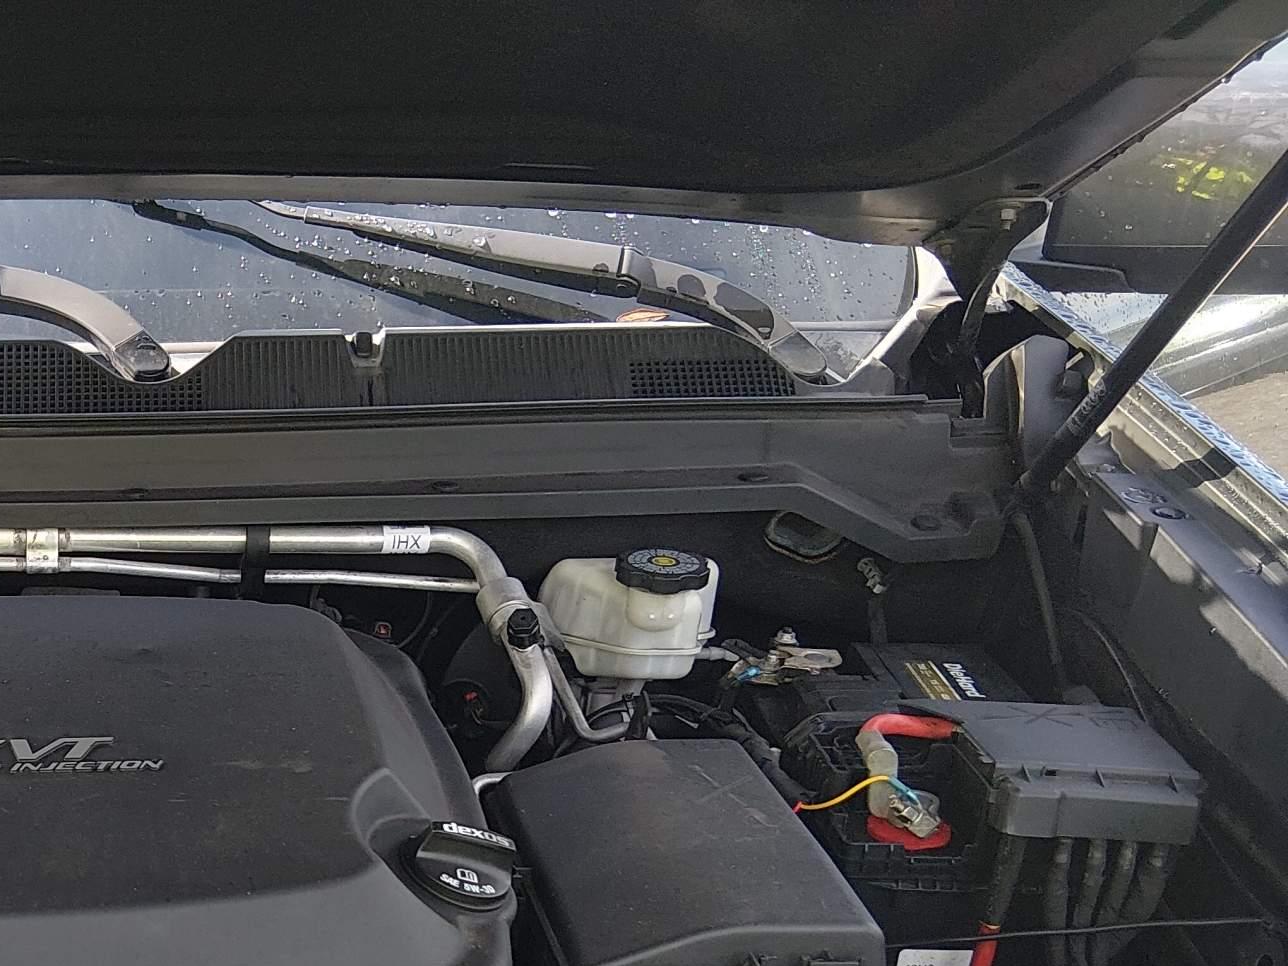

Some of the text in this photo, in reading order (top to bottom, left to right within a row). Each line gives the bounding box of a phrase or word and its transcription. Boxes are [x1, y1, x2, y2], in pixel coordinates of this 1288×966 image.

[392, 535, 421, 549] IHX
[942, 663, 987, 698] DieHard
[10, 758, 165, 773] INJECTION
[443, 823, 510, 846] dexos
[439, 873, 495, 894] SAE 5W-30
